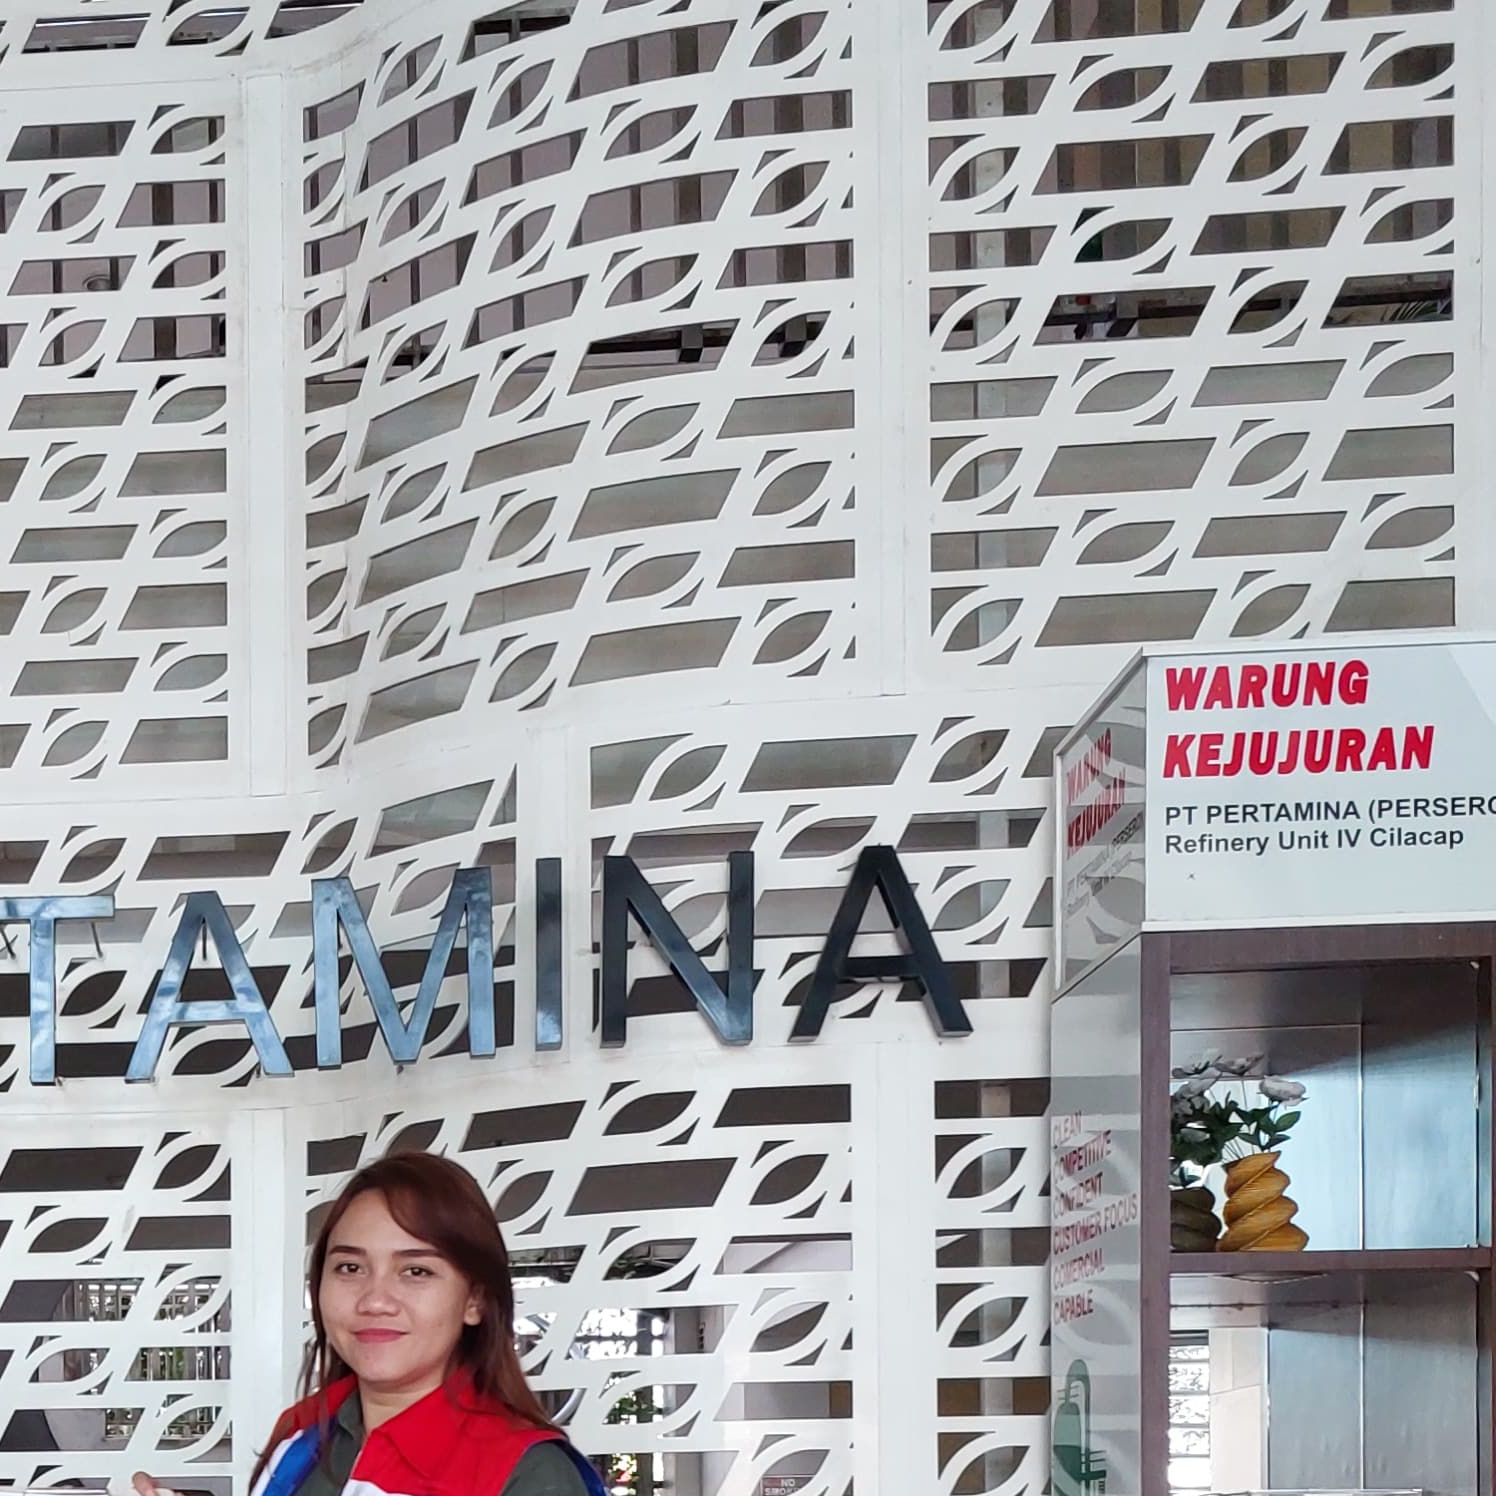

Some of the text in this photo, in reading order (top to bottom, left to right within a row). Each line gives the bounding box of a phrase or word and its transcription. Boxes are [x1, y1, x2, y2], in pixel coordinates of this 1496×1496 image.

[1165, 659, 1369, 712] WARUNG
[1162, 725, 1435, 779] KEJUJURAN
[1165, 804, 1198, 826] PT
[1206, 800, 1359, 825] PERTAMINA
[1165, 826, 1464, 857] Refinery Unit IV Cilacap
[1103, 1192, 1138, 1233] FOCUS
